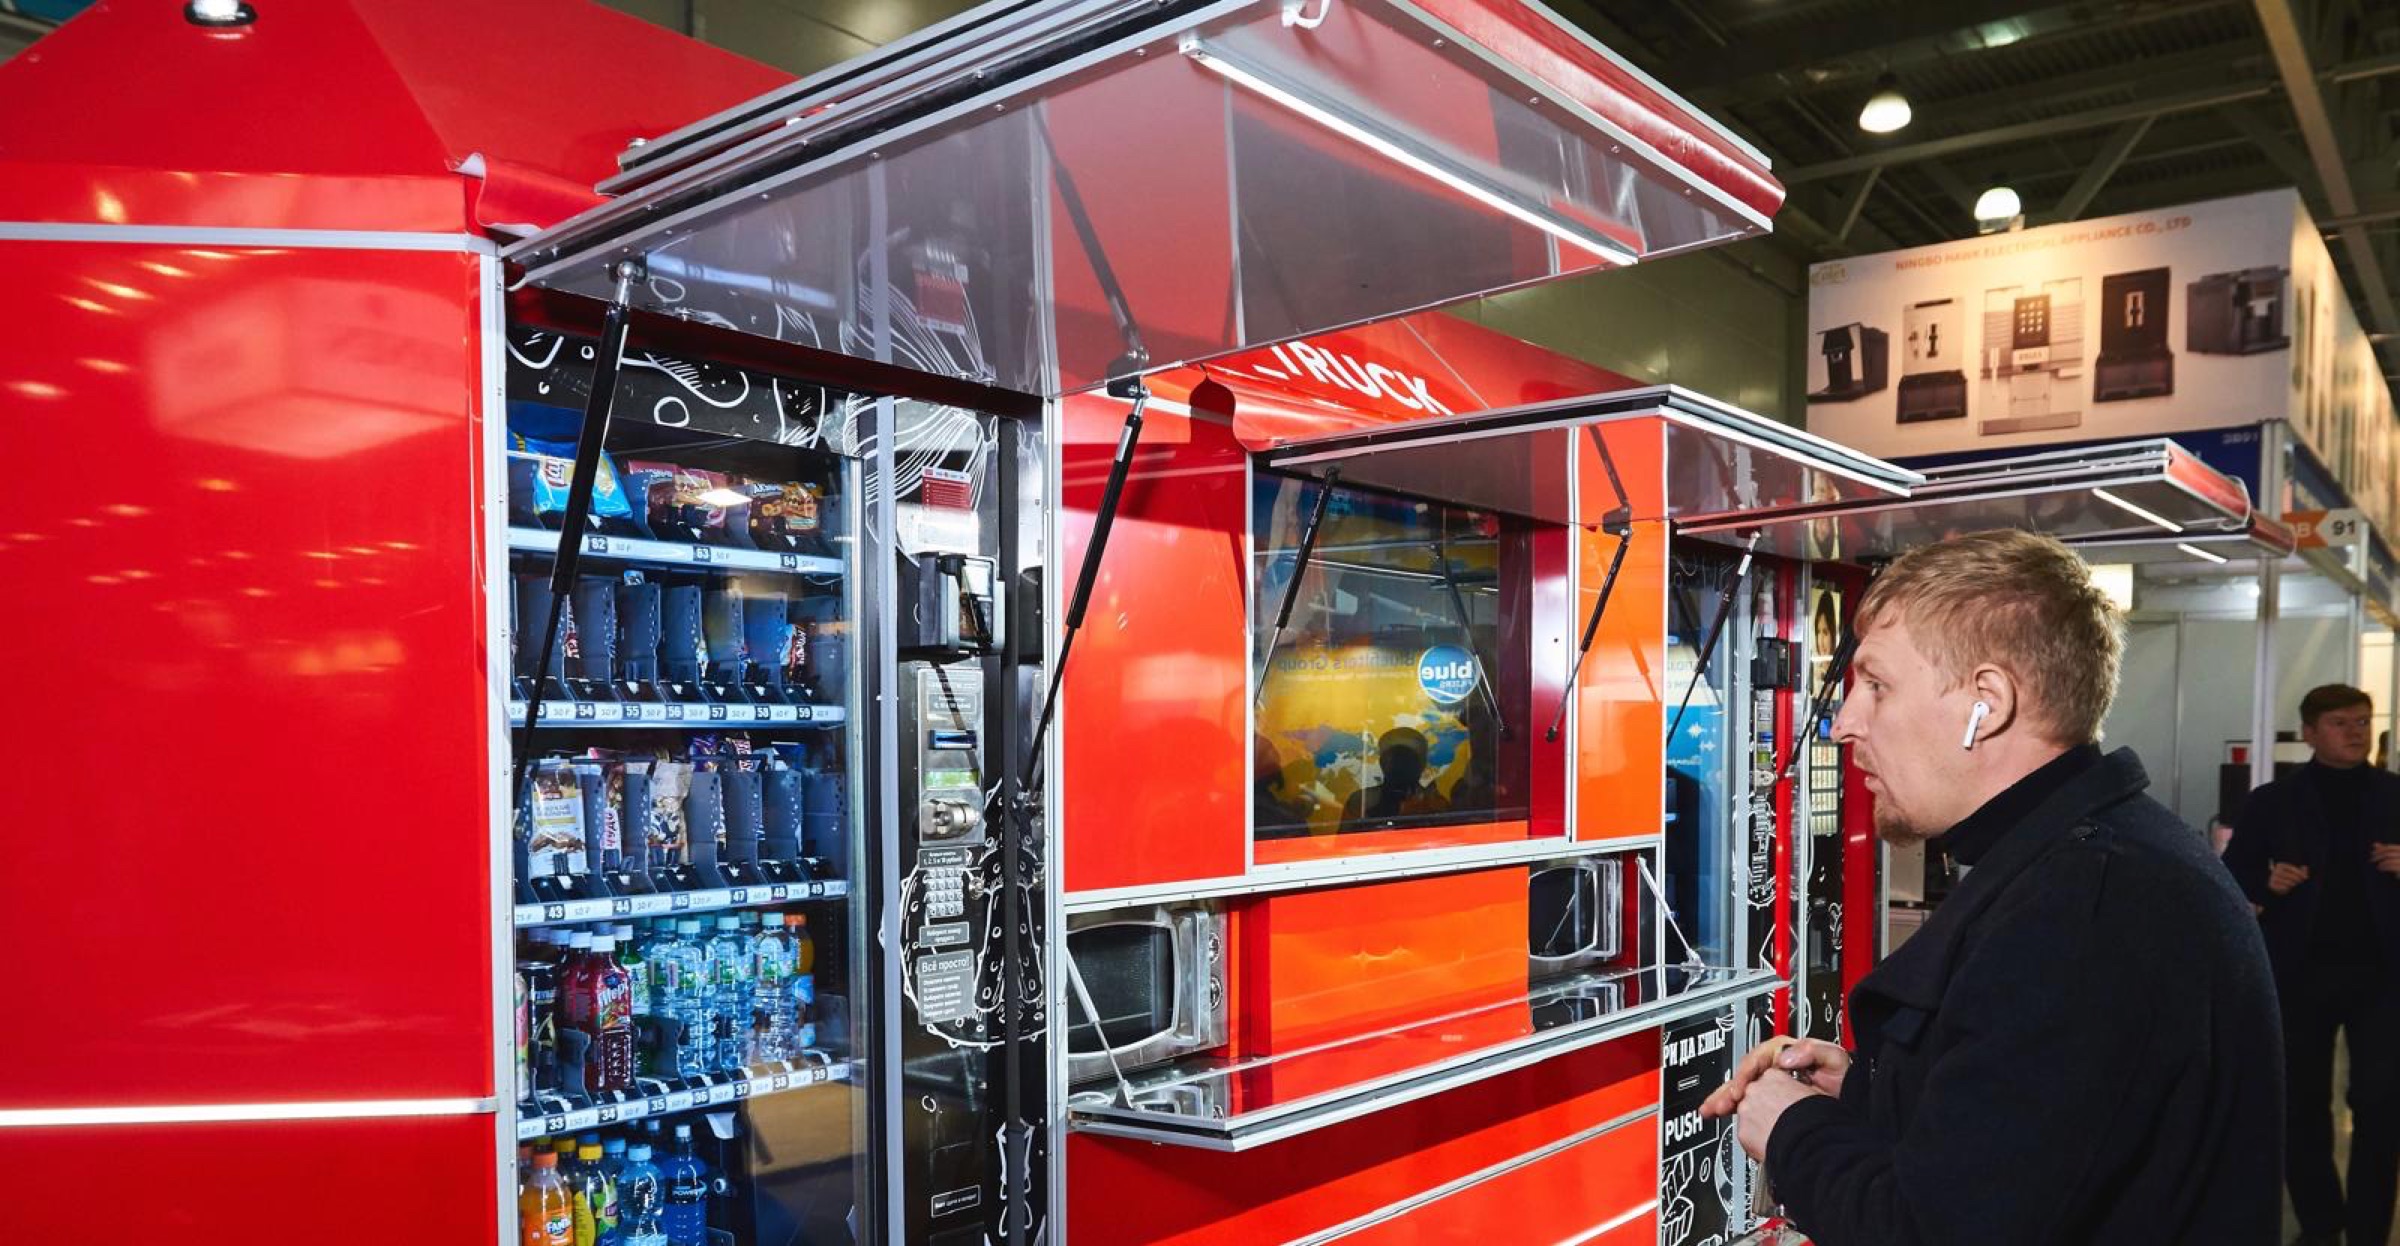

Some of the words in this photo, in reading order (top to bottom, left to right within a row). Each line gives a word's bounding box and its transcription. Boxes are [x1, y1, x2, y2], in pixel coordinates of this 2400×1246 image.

[1895, 255, 1942, 271] NINGBO
[2062, 225, 2132, 244] APPLIANCE
[2166, 215, 2193, 230] LTD
[2333, 519, 2356, 536] 91
[922, 960, 937, 973] Всё
[938, 955, 970, 971] просто!
[1679, 1036, 1696, 1067] ДА
[548, 1117, 565, 1131] 33
[601, 1108, 616, 1121] 34
[651, 1100, 665, 1111] 35
[1664, 1109, 1703, 1147] PUSH
